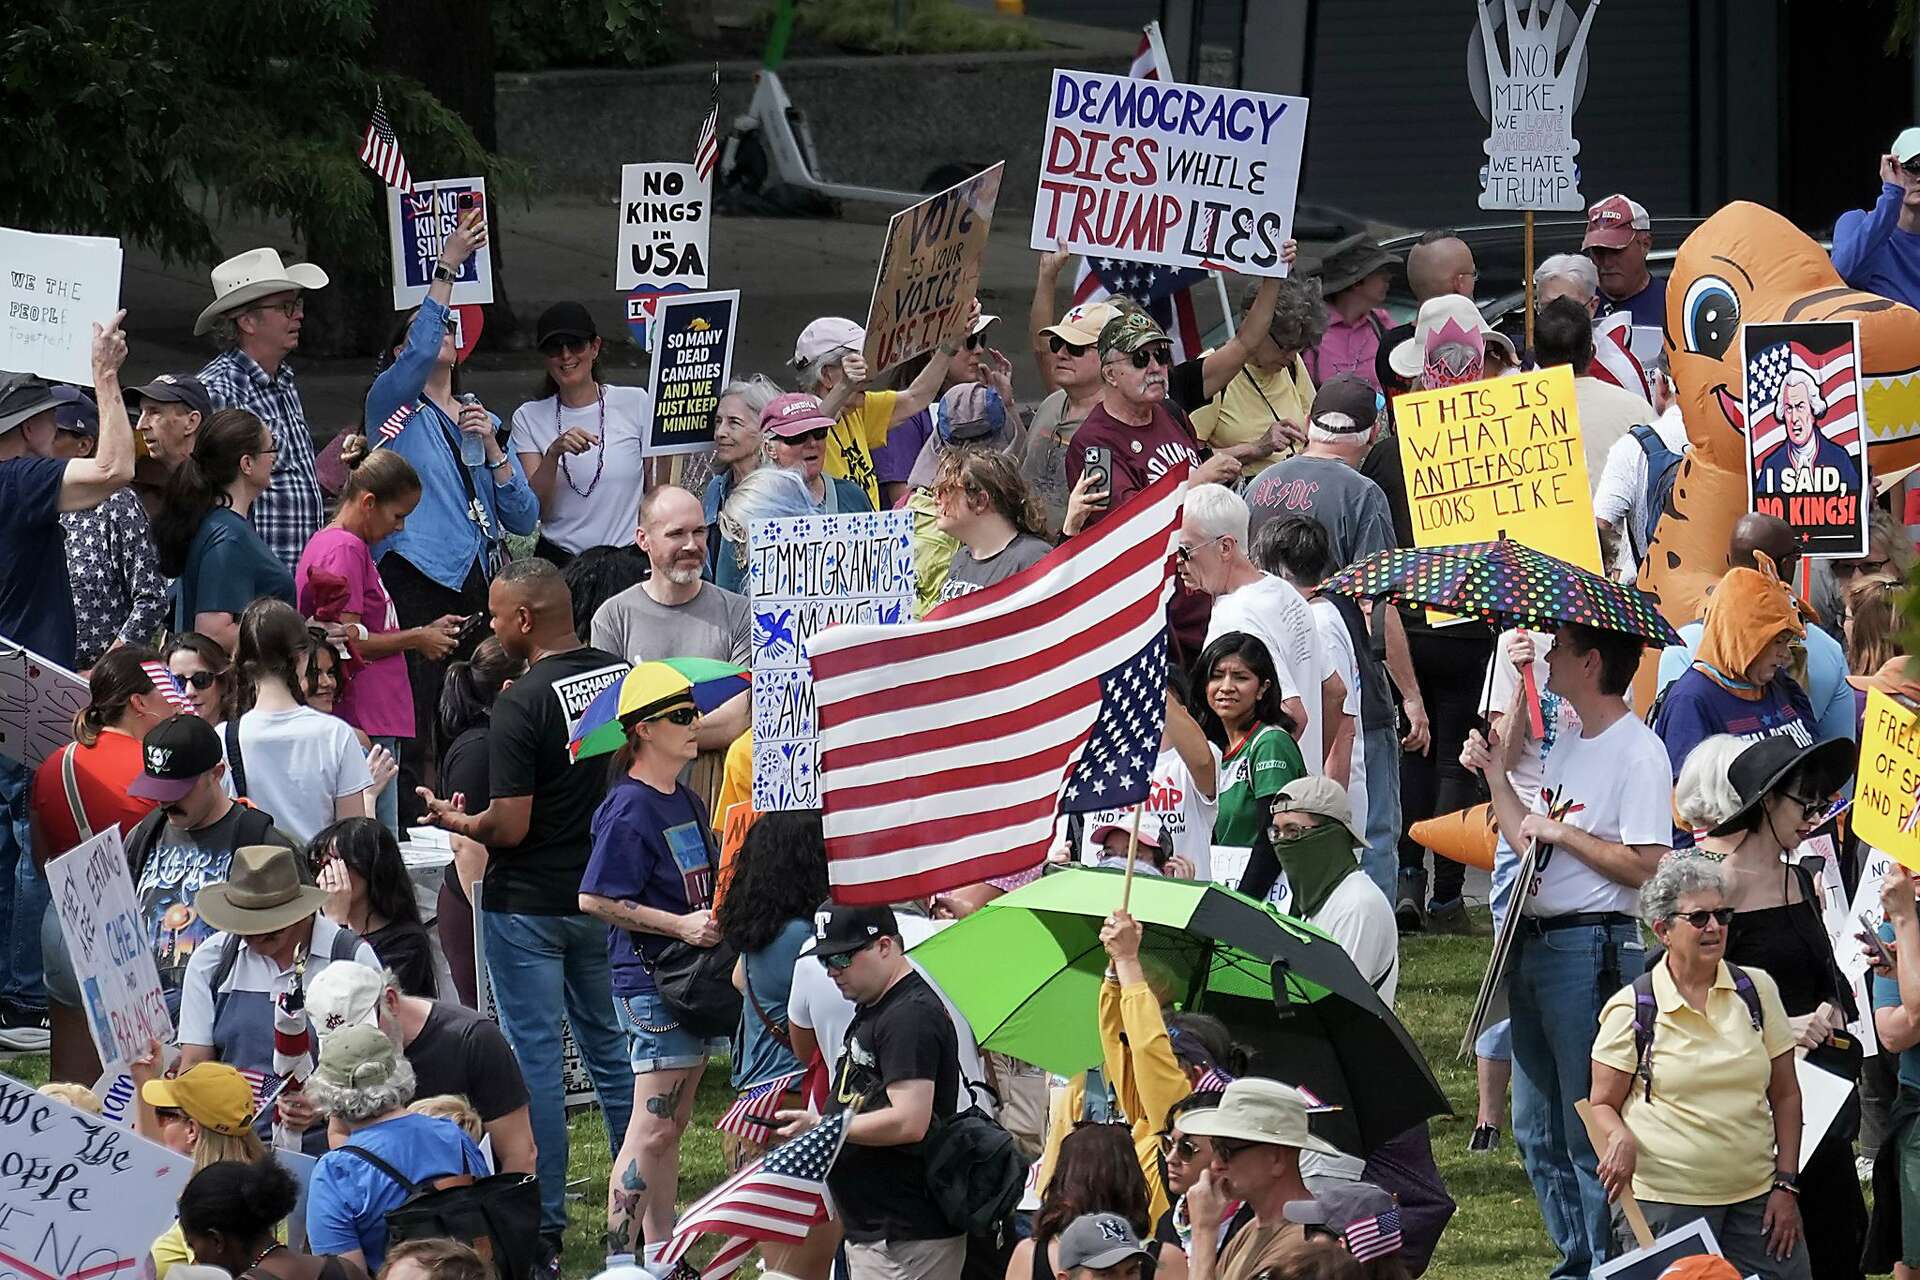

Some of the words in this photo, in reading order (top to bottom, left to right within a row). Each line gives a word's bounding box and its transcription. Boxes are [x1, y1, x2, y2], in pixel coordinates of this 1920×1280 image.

[1515, 44, 1548, 78] NO
[1054, 74, 1288, 145] DEMOCRACY
[1495, 84, 1564, 114] MIKE,
[1495, 115, 1517, 130] WE
[1524, 114, 1563, 132] LOVE
[1491, 133, 1569, 151] AMERICA.
[1046, 126, 1159, 186] DIES
[1167, 146, 1267, 195] WHILE
[1492, 156, 1517, 173] WE
[1521, 155, 1564, 173] HATE
[643, 171, 684, 196] NO
[1490, 177, 1569, 204] TRUMP
[626, 201, 703, 224] KINGS
[909, 178, 984, 256] VOTE
[1040, 179, 1182, 253] TRUMP
[1182, 200, 1281, 268] LIES
[652, 230, 671, 240] IN
[631, 242, 706, 277] USA
[907, 257, 925, 280] IS
[931, 242, 964, 273] YOUR
[11, 271, 37, 291] WE
[45, 278, 82, 301] THE
[896, 267, 962, 323] VOICE
[9, 301, 69, 325] PEOPLE
[667, 333, 684, 349] SO
[685, 328, 723, 348] MANY
[676, 347, 710, 365] DEAD
[661, 363, 721, 383] CANARIES
[663, 383, 689, 400] AND
[692, 381, 712, 396] WE
[1406, 388, 1496, 427] THIS
[1512, 379, 1550, 410] IS
[656, 400, 685, 417] JUST
[686, 397, 718, 414] KEEP
[662, 415, 708, 433] MINING
[1408, 416, 1512, 462] WHAT
[1529, 407, 1567, 441] AN
[1413, 438, 1577, 497] ANTI-FASCIST
[1766, 467, 1774, 494] I
[1780, 466, 1847, 498] SAID,
[1418, 494, 1475, 531] LOOKS
[1492, 473, 1574, 516] LIKE
[1756, 496, 1784, 520] NO
[1789, 495, 1857, 526] KINGS!
[754, 536, 900, 597] IMMIGRANTS
[1875, 753, 1897, 778] OF
[1862, 784, 1891, 816] AND
[1158, 812, 1185, 824] YOU
[105, 908, 147, 968] CHEX
